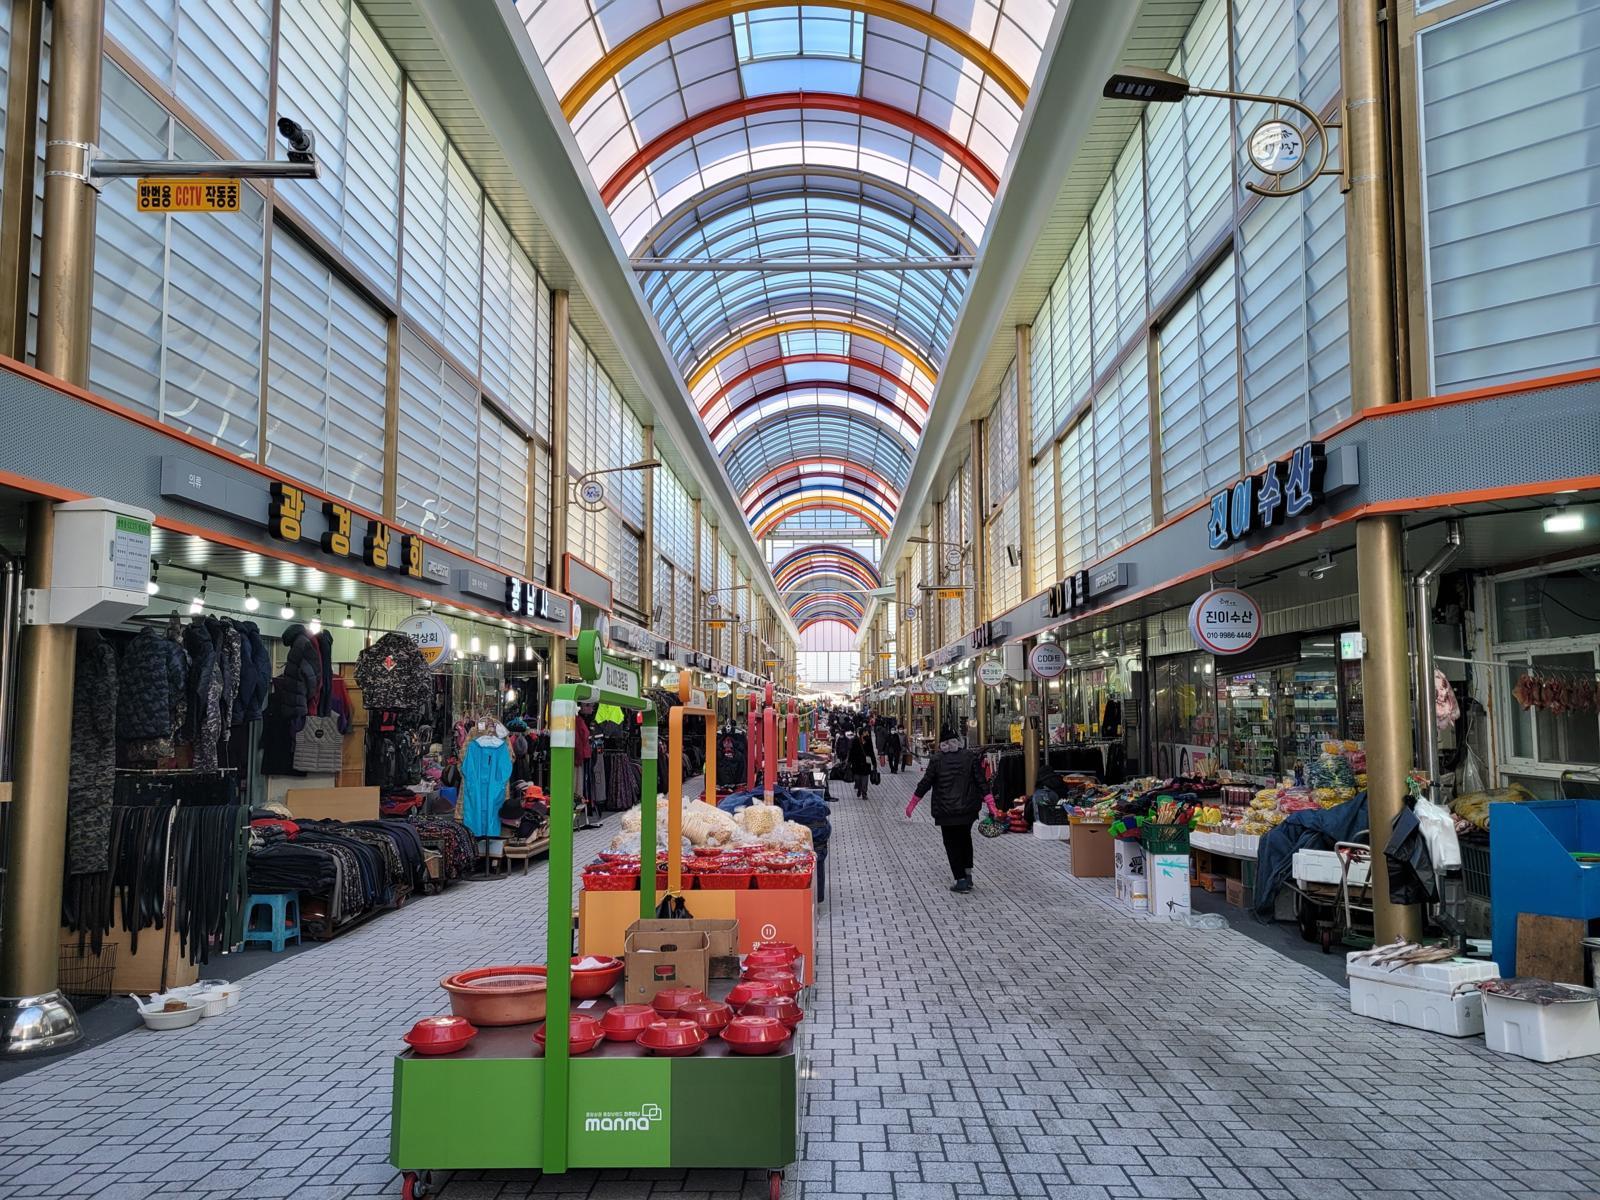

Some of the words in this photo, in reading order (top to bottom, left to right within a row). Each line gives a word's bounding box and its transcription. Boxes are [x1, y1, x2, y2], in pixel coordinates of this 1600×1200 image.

[141, 185, 171, 208] 방범용
[175, 185, 202, 207] CCTV
[205, 185, 237, 208] 작동중
[188, 473, 202, 489] 의류
[1208, 442, 1313, 550] 진이수산
[278, 483, 424, 579] 광경상회
[1205, 610, 1253, 624] 진이수산
[407, 632, 438, 644] 경상회
[585, 1117, 650, 1132] manna
